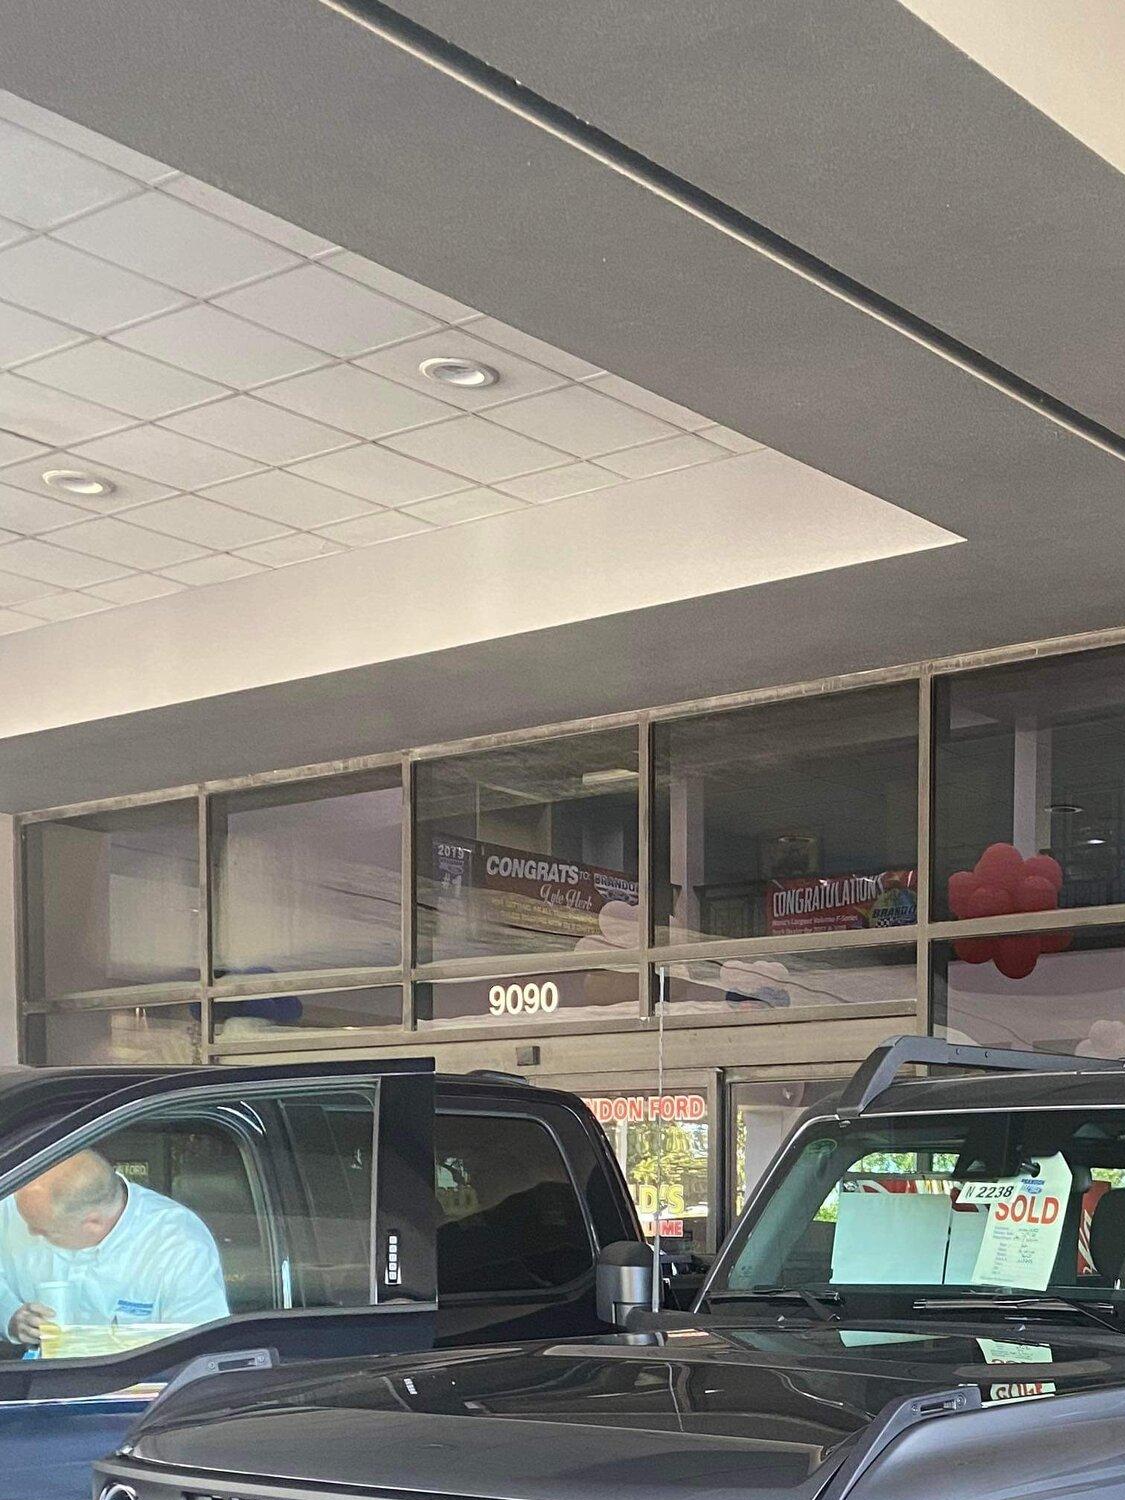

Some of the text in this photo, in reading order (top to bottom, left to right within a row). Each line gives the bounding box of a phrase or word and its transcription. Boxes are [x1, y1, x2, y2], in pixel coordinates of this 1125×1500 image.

[486, 855, 580, 885] CONGRATS
[594, 873, 638, 892] BRANDO
[489, 981, 559, 1016] 9090
[648, 1095, 706, 1120] FORD
[975, 1185, 1015, 1199] 2238
[994, 1194, 1060, 1225] SOLD
